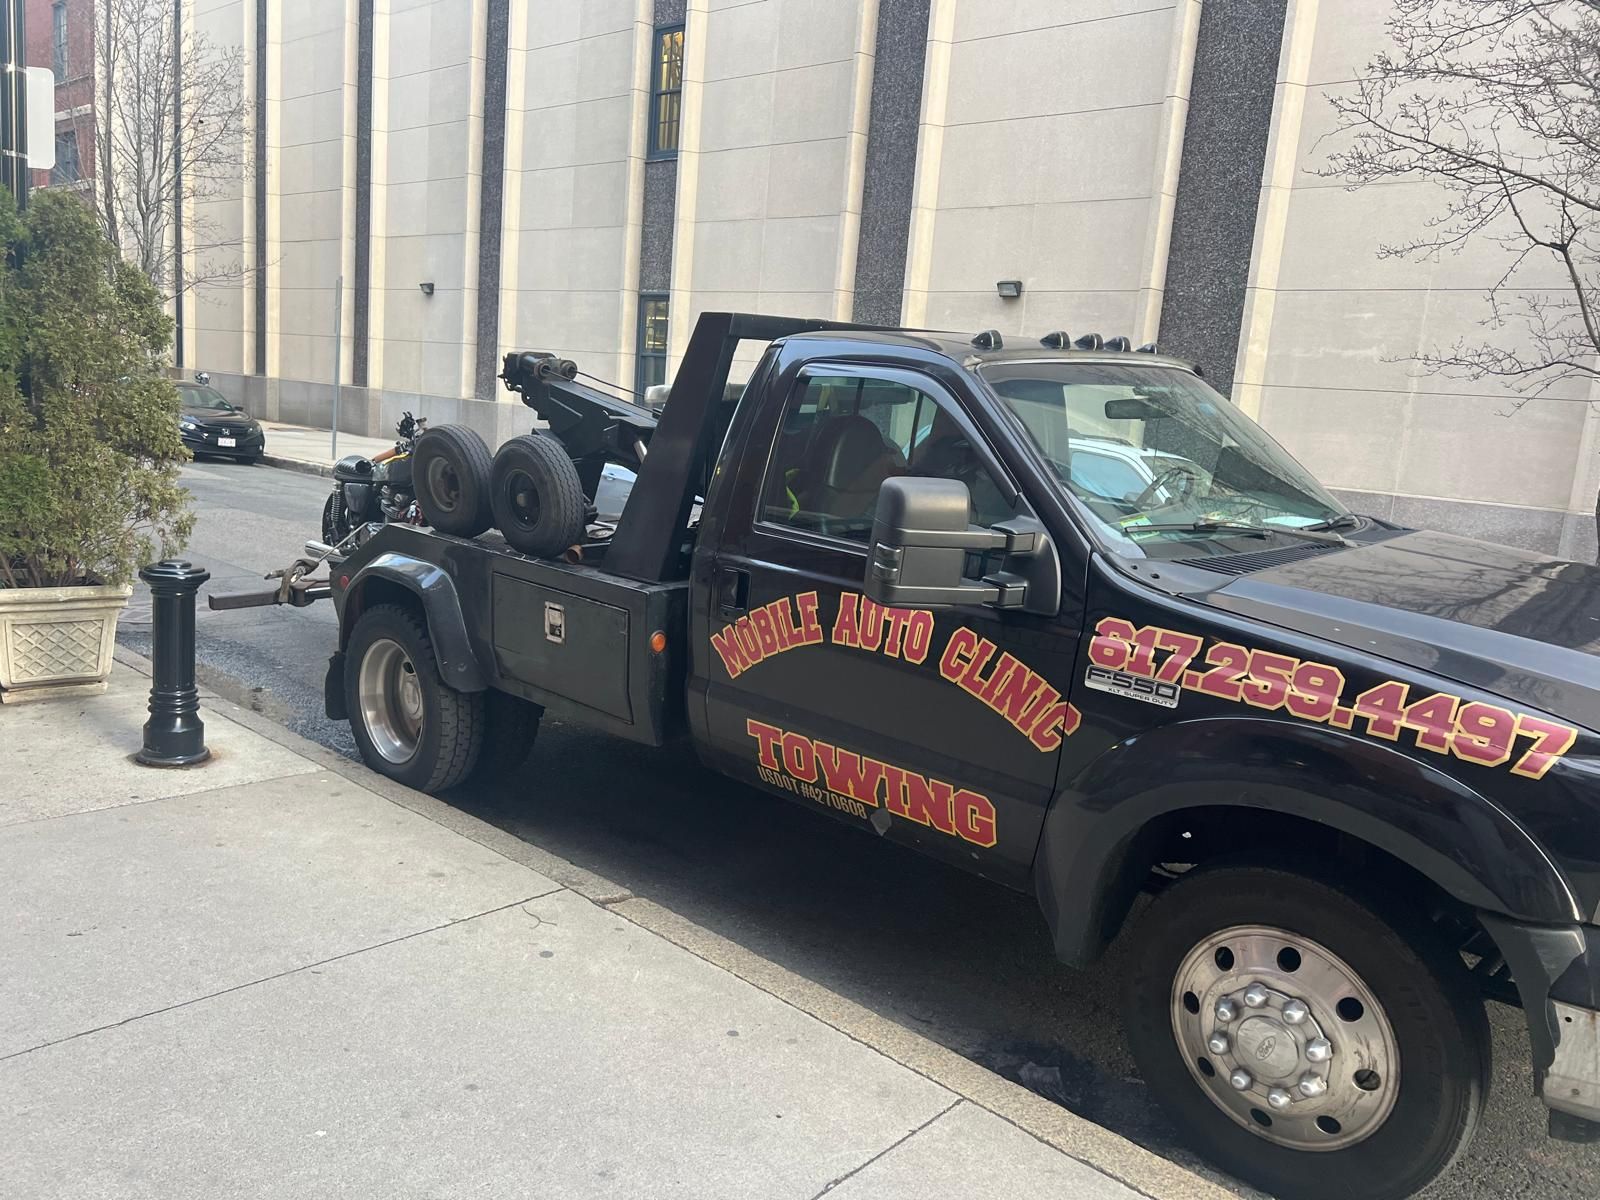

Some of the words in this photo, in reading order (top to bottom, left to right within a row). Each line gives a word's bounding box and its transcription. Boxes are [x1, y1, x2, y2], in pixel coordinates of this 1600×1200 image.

[710, 591, 823, 679] MOBILE
[832, 591, 935, 665] AUTO
[939, 627, 1082, 753] CLINIC
[1088, 616, 1578, 780] 617.259.4497
[1107, 686, 1121, 695] XLT
[1124, 691, 1150, 701] SUPER
[1151, 697, 1174, 706] DUTY
[747, 718, 998, 848] TOWING
[757, 765, 799, 795] USDOT
